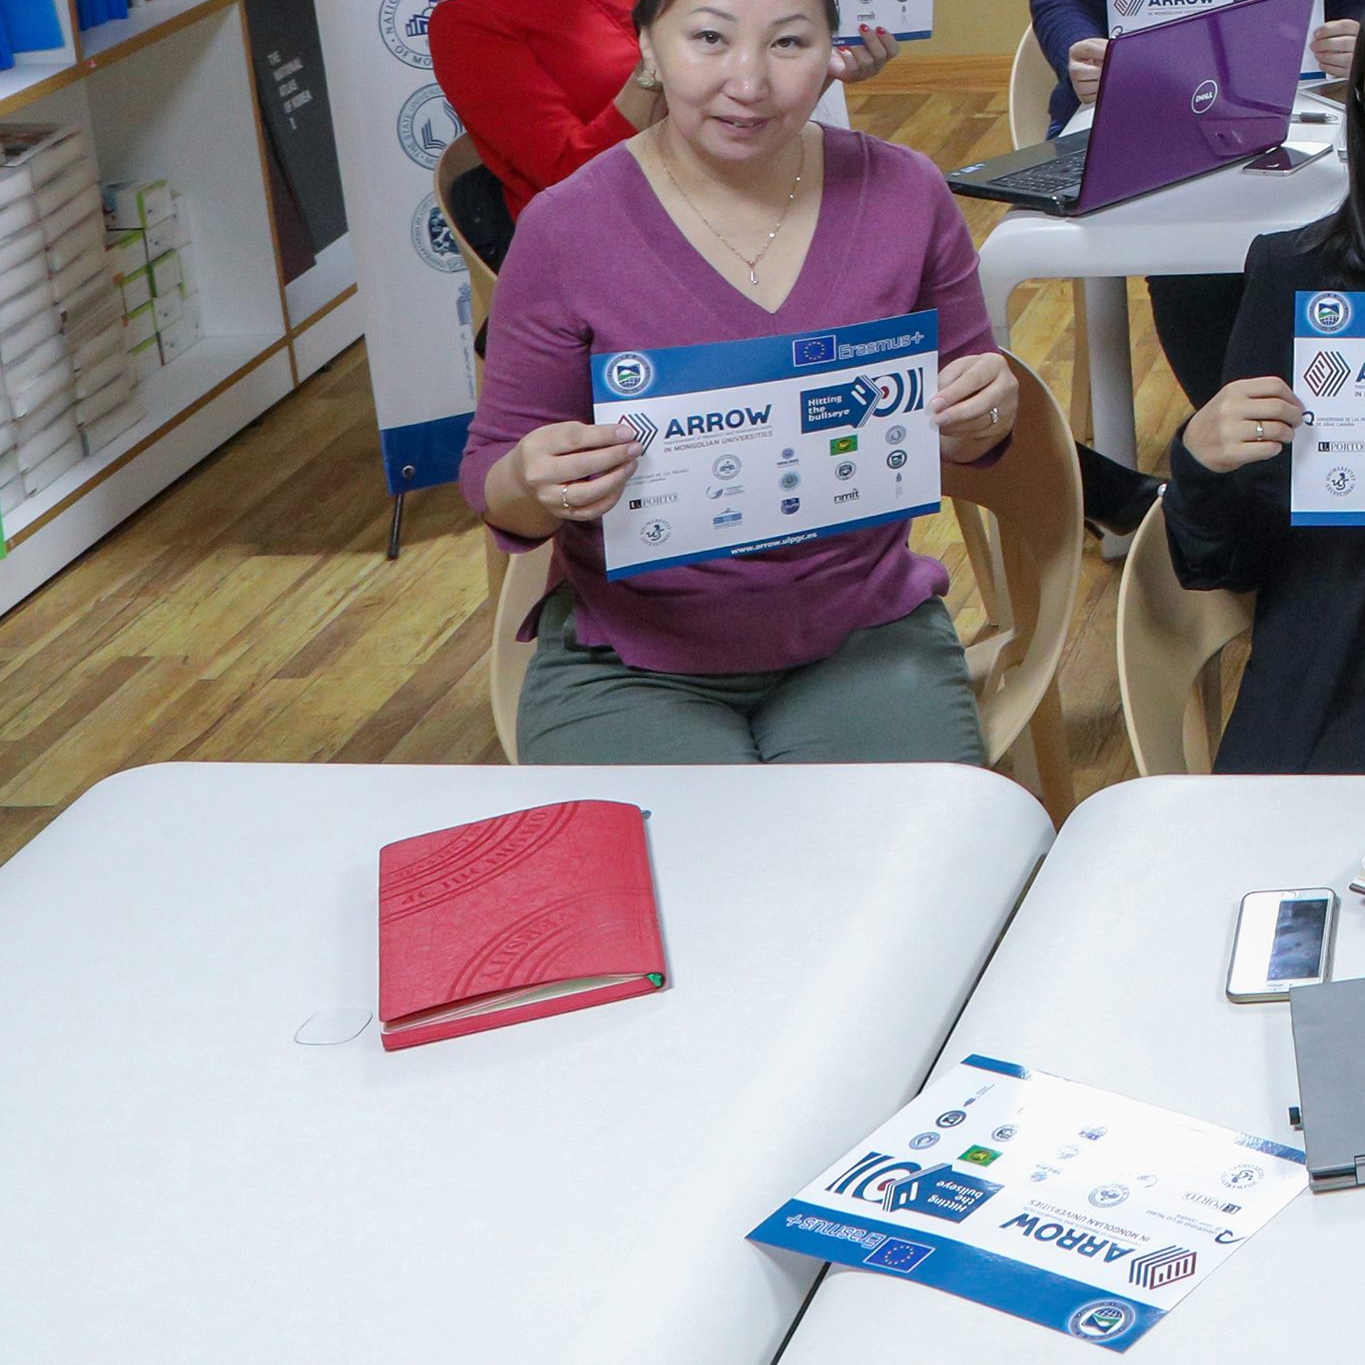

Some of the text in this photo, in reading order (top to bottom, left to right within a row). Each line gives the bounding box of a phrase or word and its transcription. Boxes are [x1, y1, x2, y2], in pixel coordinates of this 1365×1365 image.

[394, 45, 408, 57] OF
[1196, 91, 1212, 103] DELL
[838, 331, 924, 359] Erasmus+
[808, 394, 842, 407] Hitting
[808, 406, 826, 414] the
[664, 404, 772, 438] ARROW
[808, 409, 850, 421] bullseye
[935, 1179, 984, 1198] bullseye
[956, 1192, 974, 1204] the
[928, 1194, 967, 1213] Hitting
[1029, 1199, 1088, 1224] UNIVERSITIES
[786, 1213, 887, 1250] Erasmus+
[1089, 1212, 1137, 1238] MONGOLIAN
[999, 1212, 1137, 1265] ARROW
